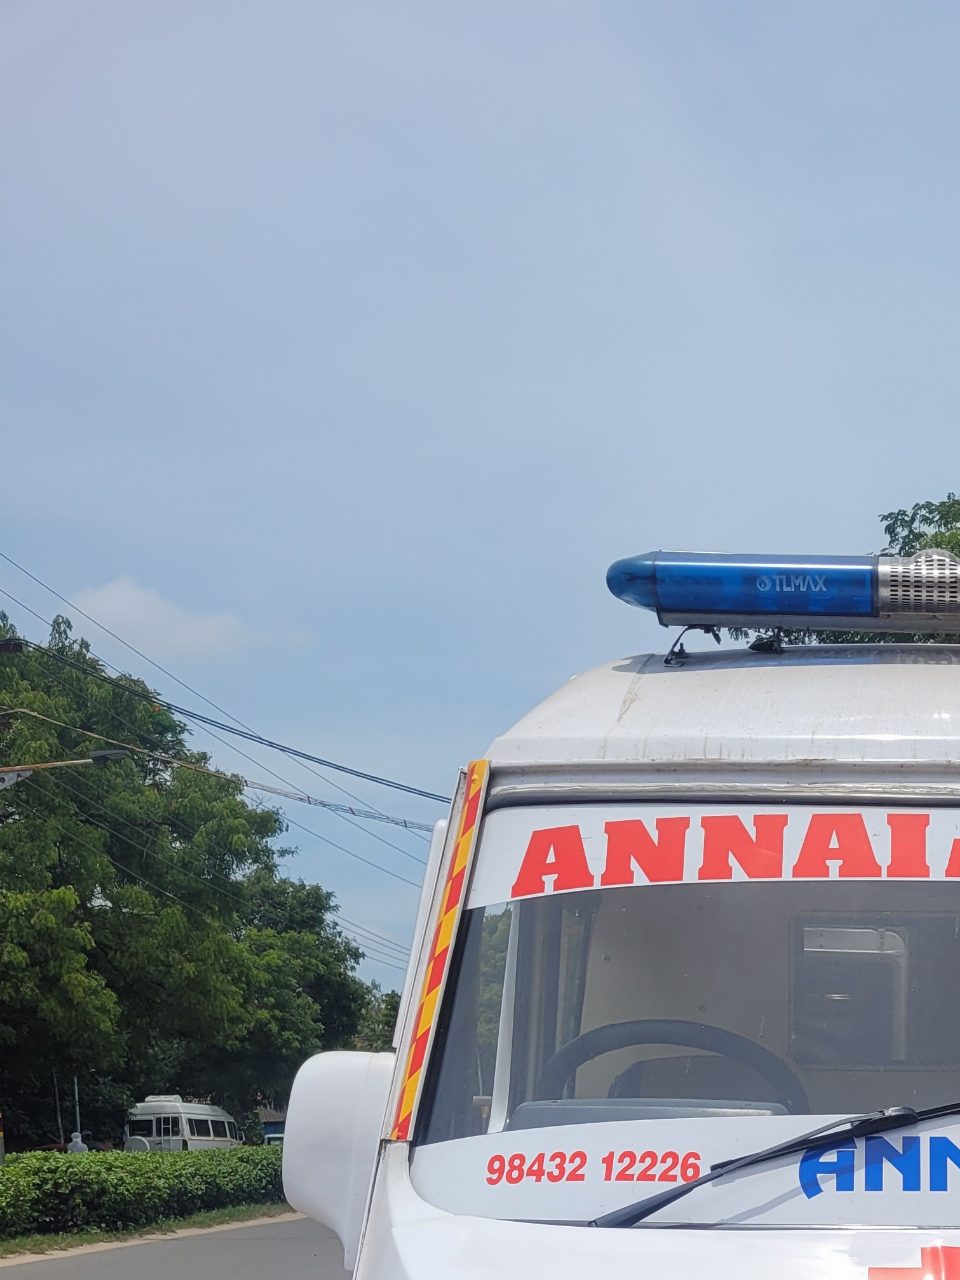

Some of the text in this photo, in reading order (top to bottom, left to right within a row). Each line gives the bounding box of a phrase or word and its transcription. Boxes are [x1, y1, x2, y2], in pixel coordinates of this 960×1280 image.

[511, 813, 930, 898] ANNAI
[486, 1150, 702, 1186] 98432 12226
